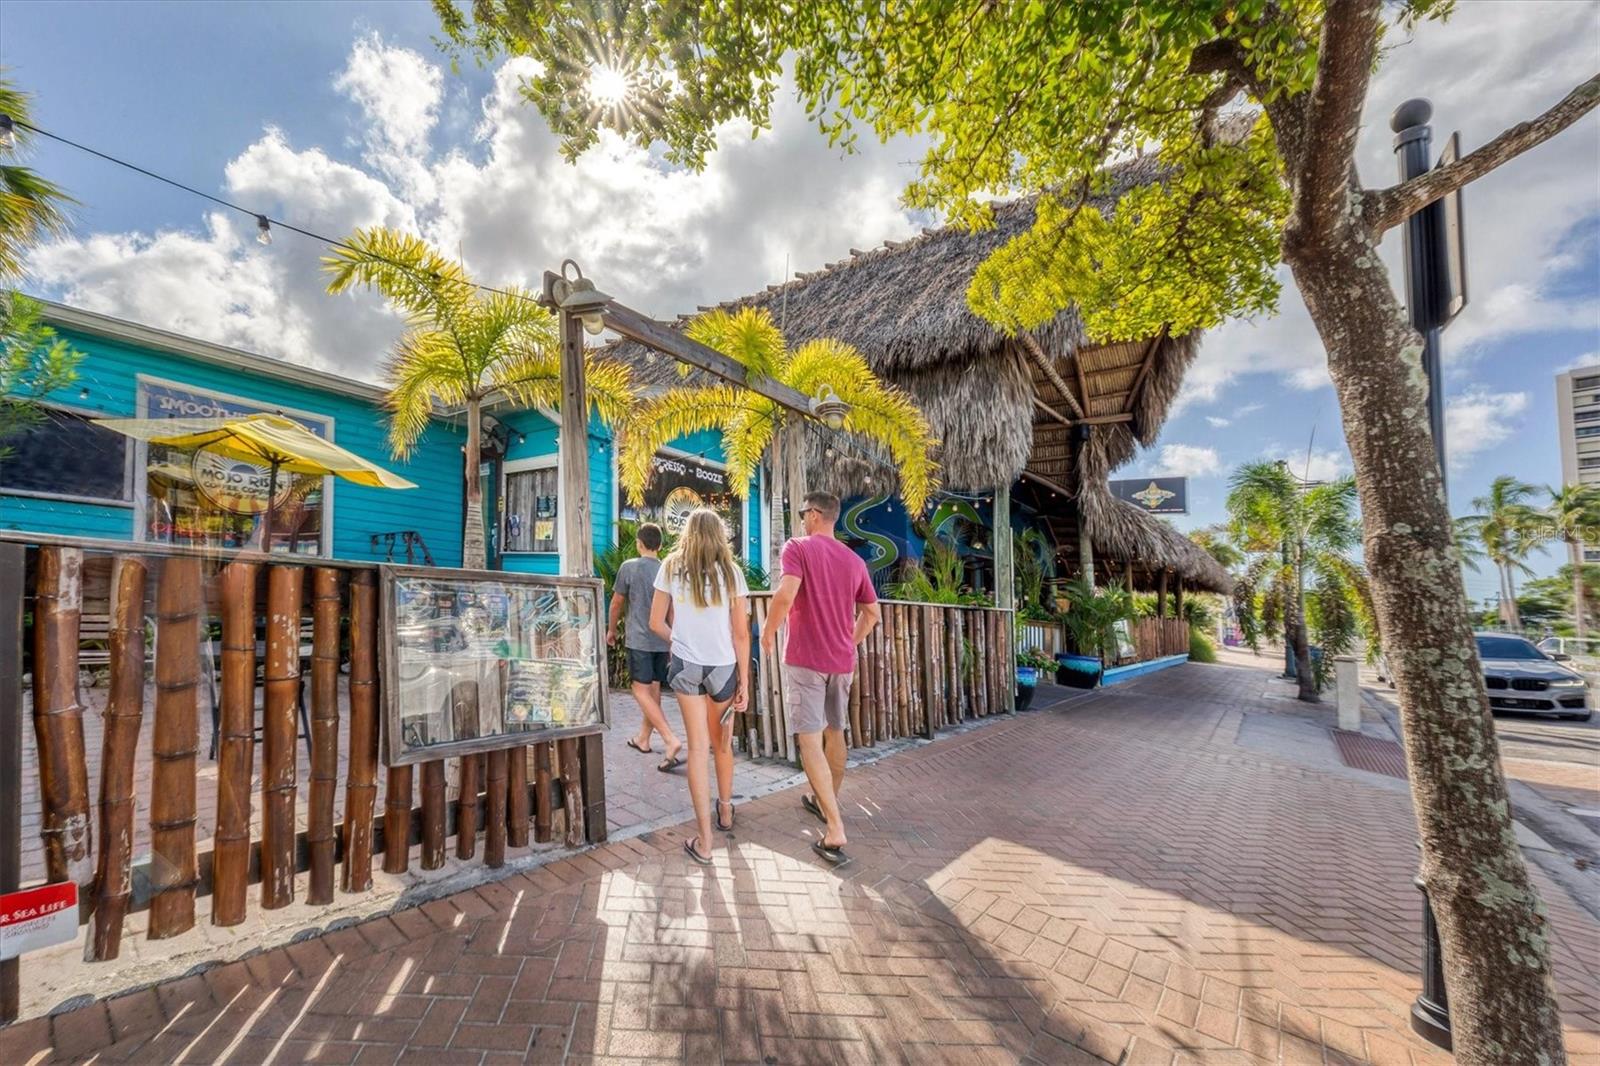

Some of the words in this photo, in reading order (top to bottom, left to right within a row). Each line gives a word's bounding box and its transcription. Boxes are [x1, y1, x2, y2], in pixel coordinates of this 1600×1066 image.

[202, 468, 243, 484] MOJO
[696, 467, 723, 485] BOOZE
[12, 908, 38, 920] SEA
[40, 900, 67, 914] LIFE
